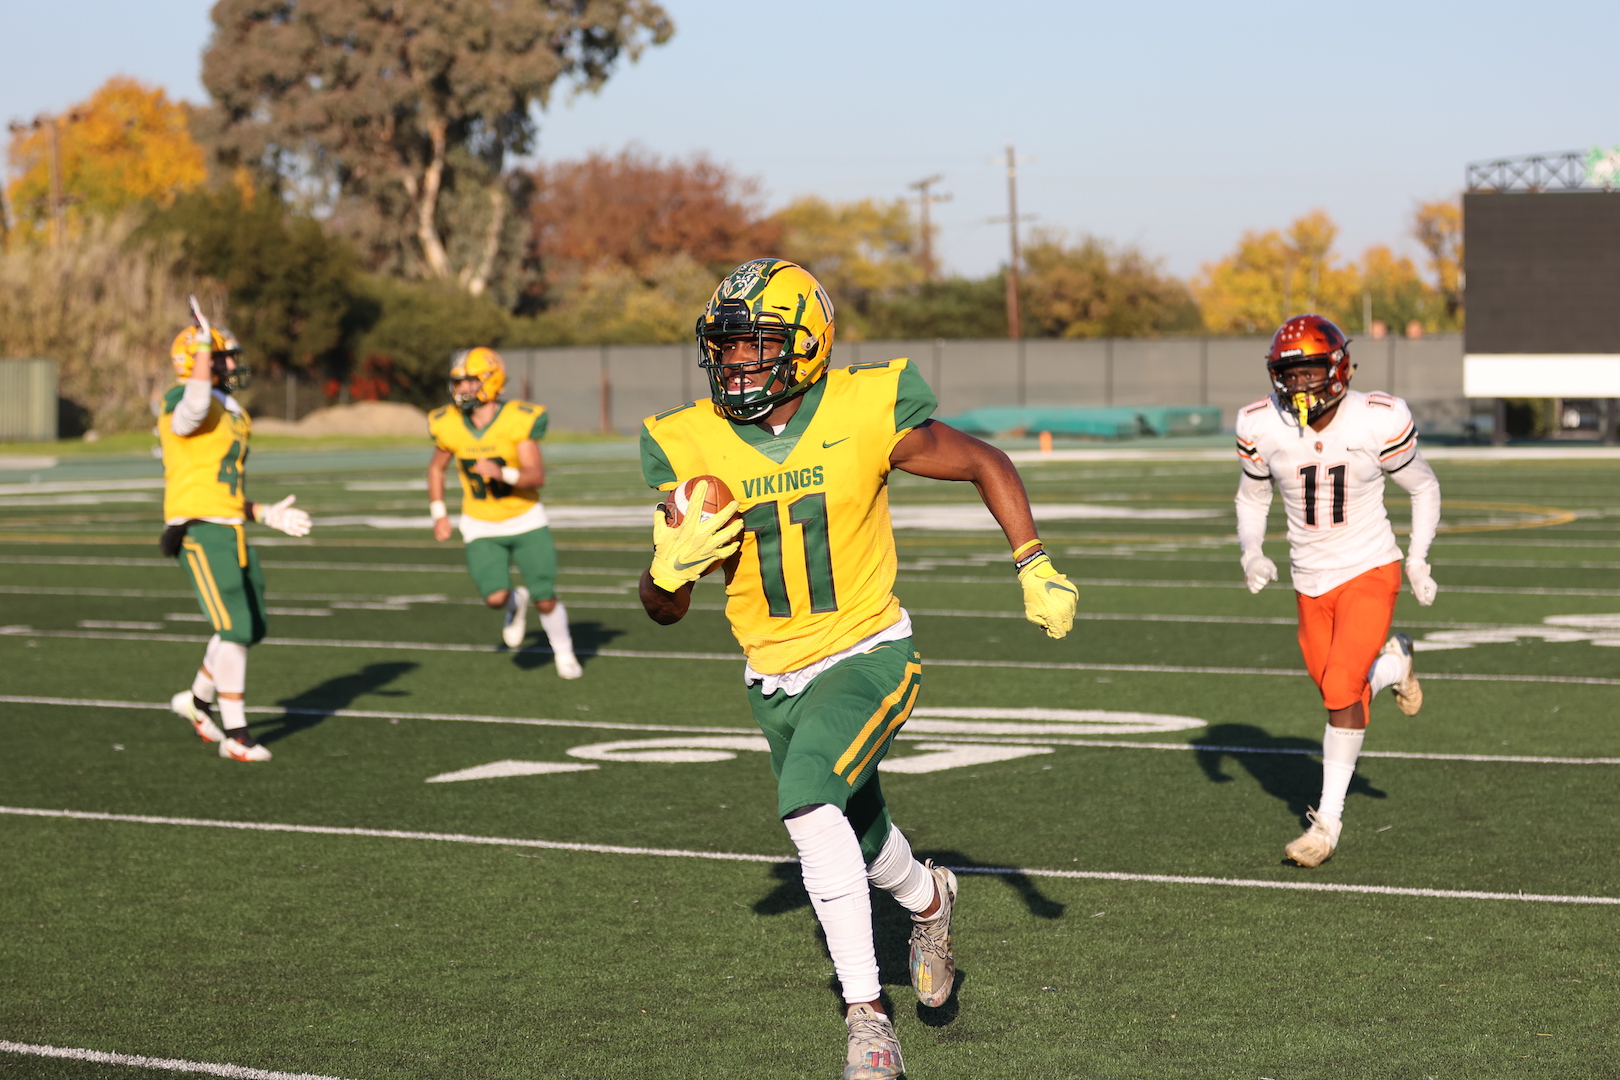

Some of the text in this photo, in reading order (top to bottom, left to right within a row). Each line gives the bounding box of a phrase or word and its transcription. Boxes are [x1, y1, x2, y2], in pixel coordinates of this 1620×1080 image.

[217, 440, 249, 497] 4
[741, 465, 824, 498] VIKINGS
[1297, 462, 1349, 529] 11
[742, 492, 839, 618] 11
